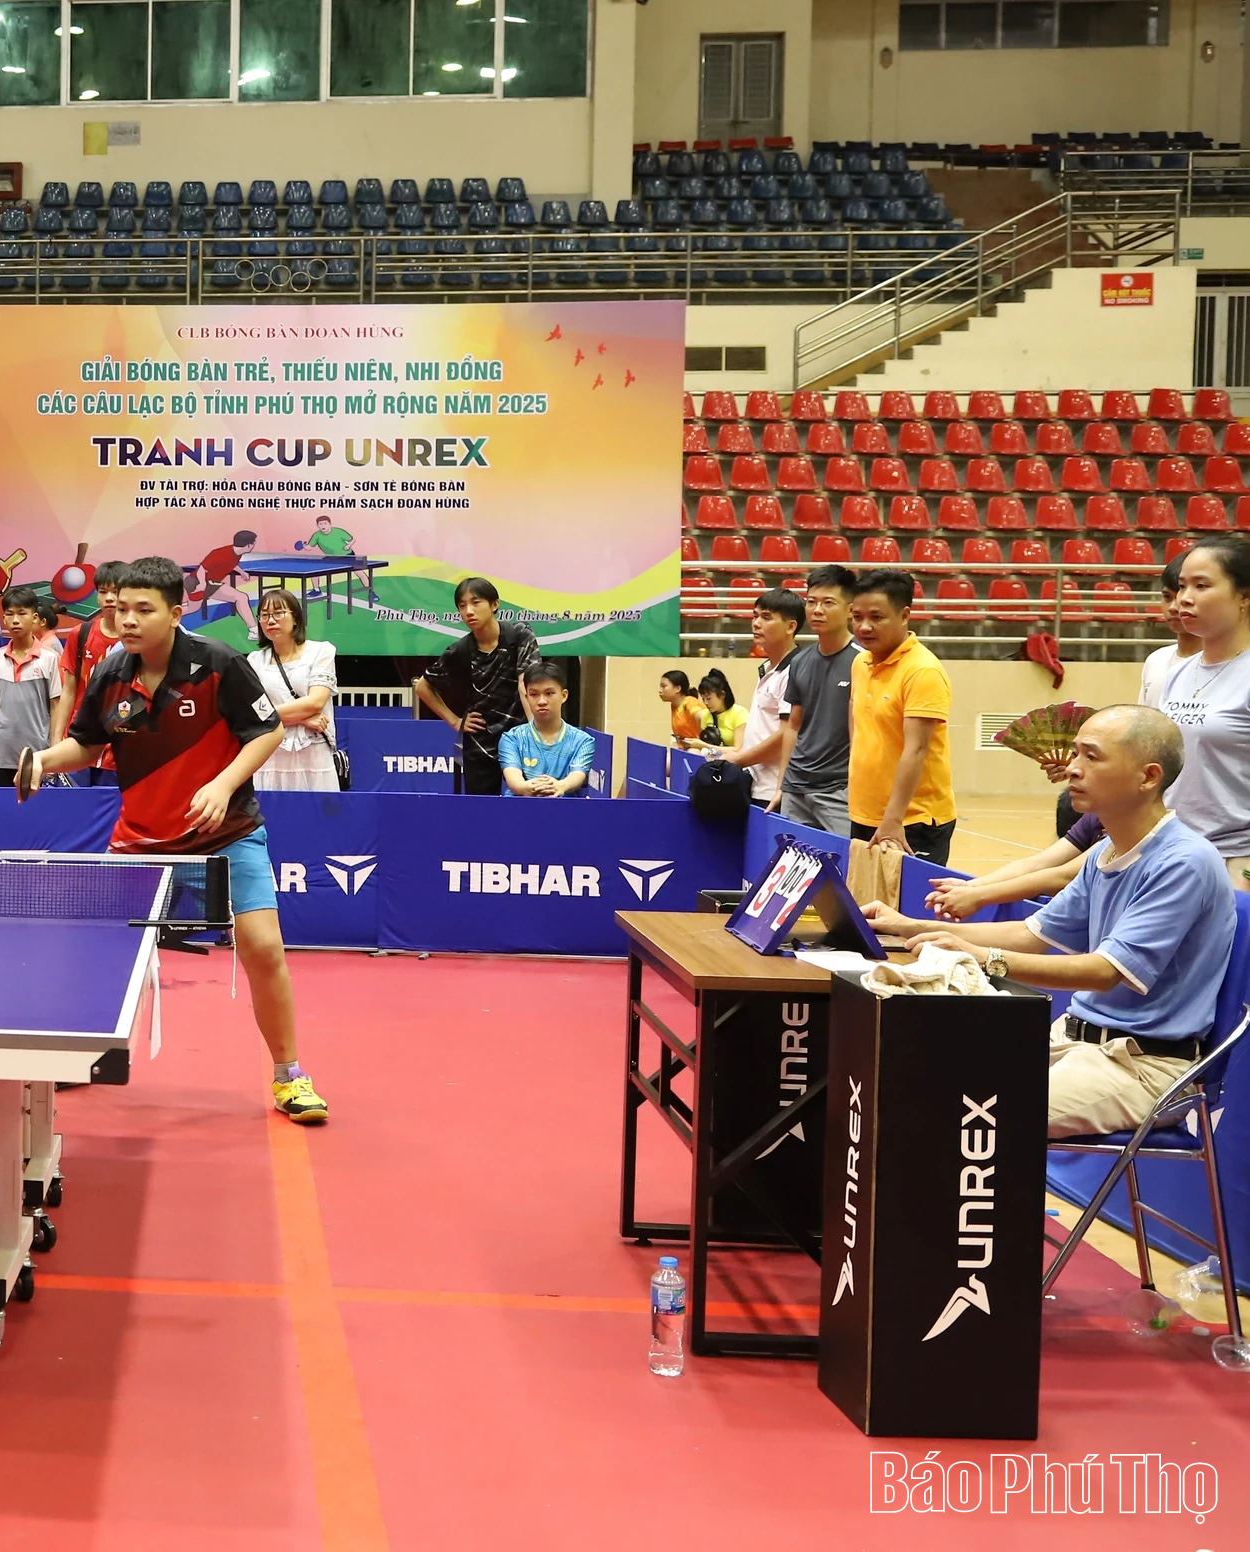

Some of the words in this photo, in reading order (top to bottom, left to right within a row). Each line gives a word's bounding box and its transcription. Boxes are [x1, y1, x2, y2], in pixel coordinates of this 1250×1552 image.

[177, 327, 210, 339] CLB
[215, 324, 261, 339] BÓNG
[266, 324, 300, 339] BÀN
[304, 326, 350, 338] ĐOAN
[356, 324, 404, 338] HÙNG
[81, 356, 121, 382] GIẢI
[126, 358, 181, 382] BÓNG
[187, 358, 228, 382] BÀN
[234, 356, 276, 384] TRẺ,
[282, 356, 338, 382] THIẾU
[344, 358, 398, 384] NIÊN,
[405, 362, 440, 381] NHI
[446, 354, 502, 381] ĐỒNG
[37, 390, 77, 414] CÁC
[82, 391, 122, 414] CÂU
[128, 395, 165, 418] LẠC
[171, 391, 198, 418] BỘ
[204, 388, 248, 414] TỈNH
[254, 391, 294, 414] PHÚ
[301, 395, 338, 418] THỌ
[344, 389, 377, 414] MỞ
[382, 391, 438, 418] RỘNG
[444, 391, 492, 414] NĂM
[498, 394, 548, 414] 2025
[91, 437, 234, 467] TRANH
[246, 437, 332, 467] CUP
[344, 437, 489, 467] UNREX
[140, 480, 156, 490] ĐV
[160, 478, 178, 490] TÀI
[182, 480, 209, 493] TRỢ:
[212, 478, 237, 491] HỎA
[240, 479, 274, 492] CHÂU
[277, 479, 311, 492] BÓNG
[315, 480, 341, 492] BÀN
[354, 480, 379, 492] SƠN
[401, 480, 435, 492] BÓNG
[439, 479, 465, 492] BÀN
[135, 496, 160, 510] HỢP
[164, 496, 186, 508] TÁC
[190, 496, 206, 508] XÃ
[210, 496, 244, 508] CÔNG
[248, 496, 280, 510] NGHỆ
[284, 498, 316, 510] THỰC
[320, 495, 356, 508] PHẨM
[360, 498, 394, 510] SẠCH
[397, 498, 432, 508] ĐOAN
[435, 496, 470, 508] HÙNG
[376, 608, 404, 621] Phú
[409, 608, 440, 624] Thọ,
[443, 611, 463, 622] ng
[498, 609, 514, 620] 10
[517, 608, 559, 622] tháng
[562, 610, 571, 620] 8
[574, 610, 605, 621] năm
[610, 610, 641, 621] 2025
[1164, 702, 1209, 712] TOMMY
[442, 861, 600, 897] TIBHAR
[753, 864, 786, 911] 3
[781, 865, 800, 890] 0
[788, 868, 807, 894] 0
[843, 1075, 862, 1248] UNREX
[957, 1094, 998, 1268] UNREX
